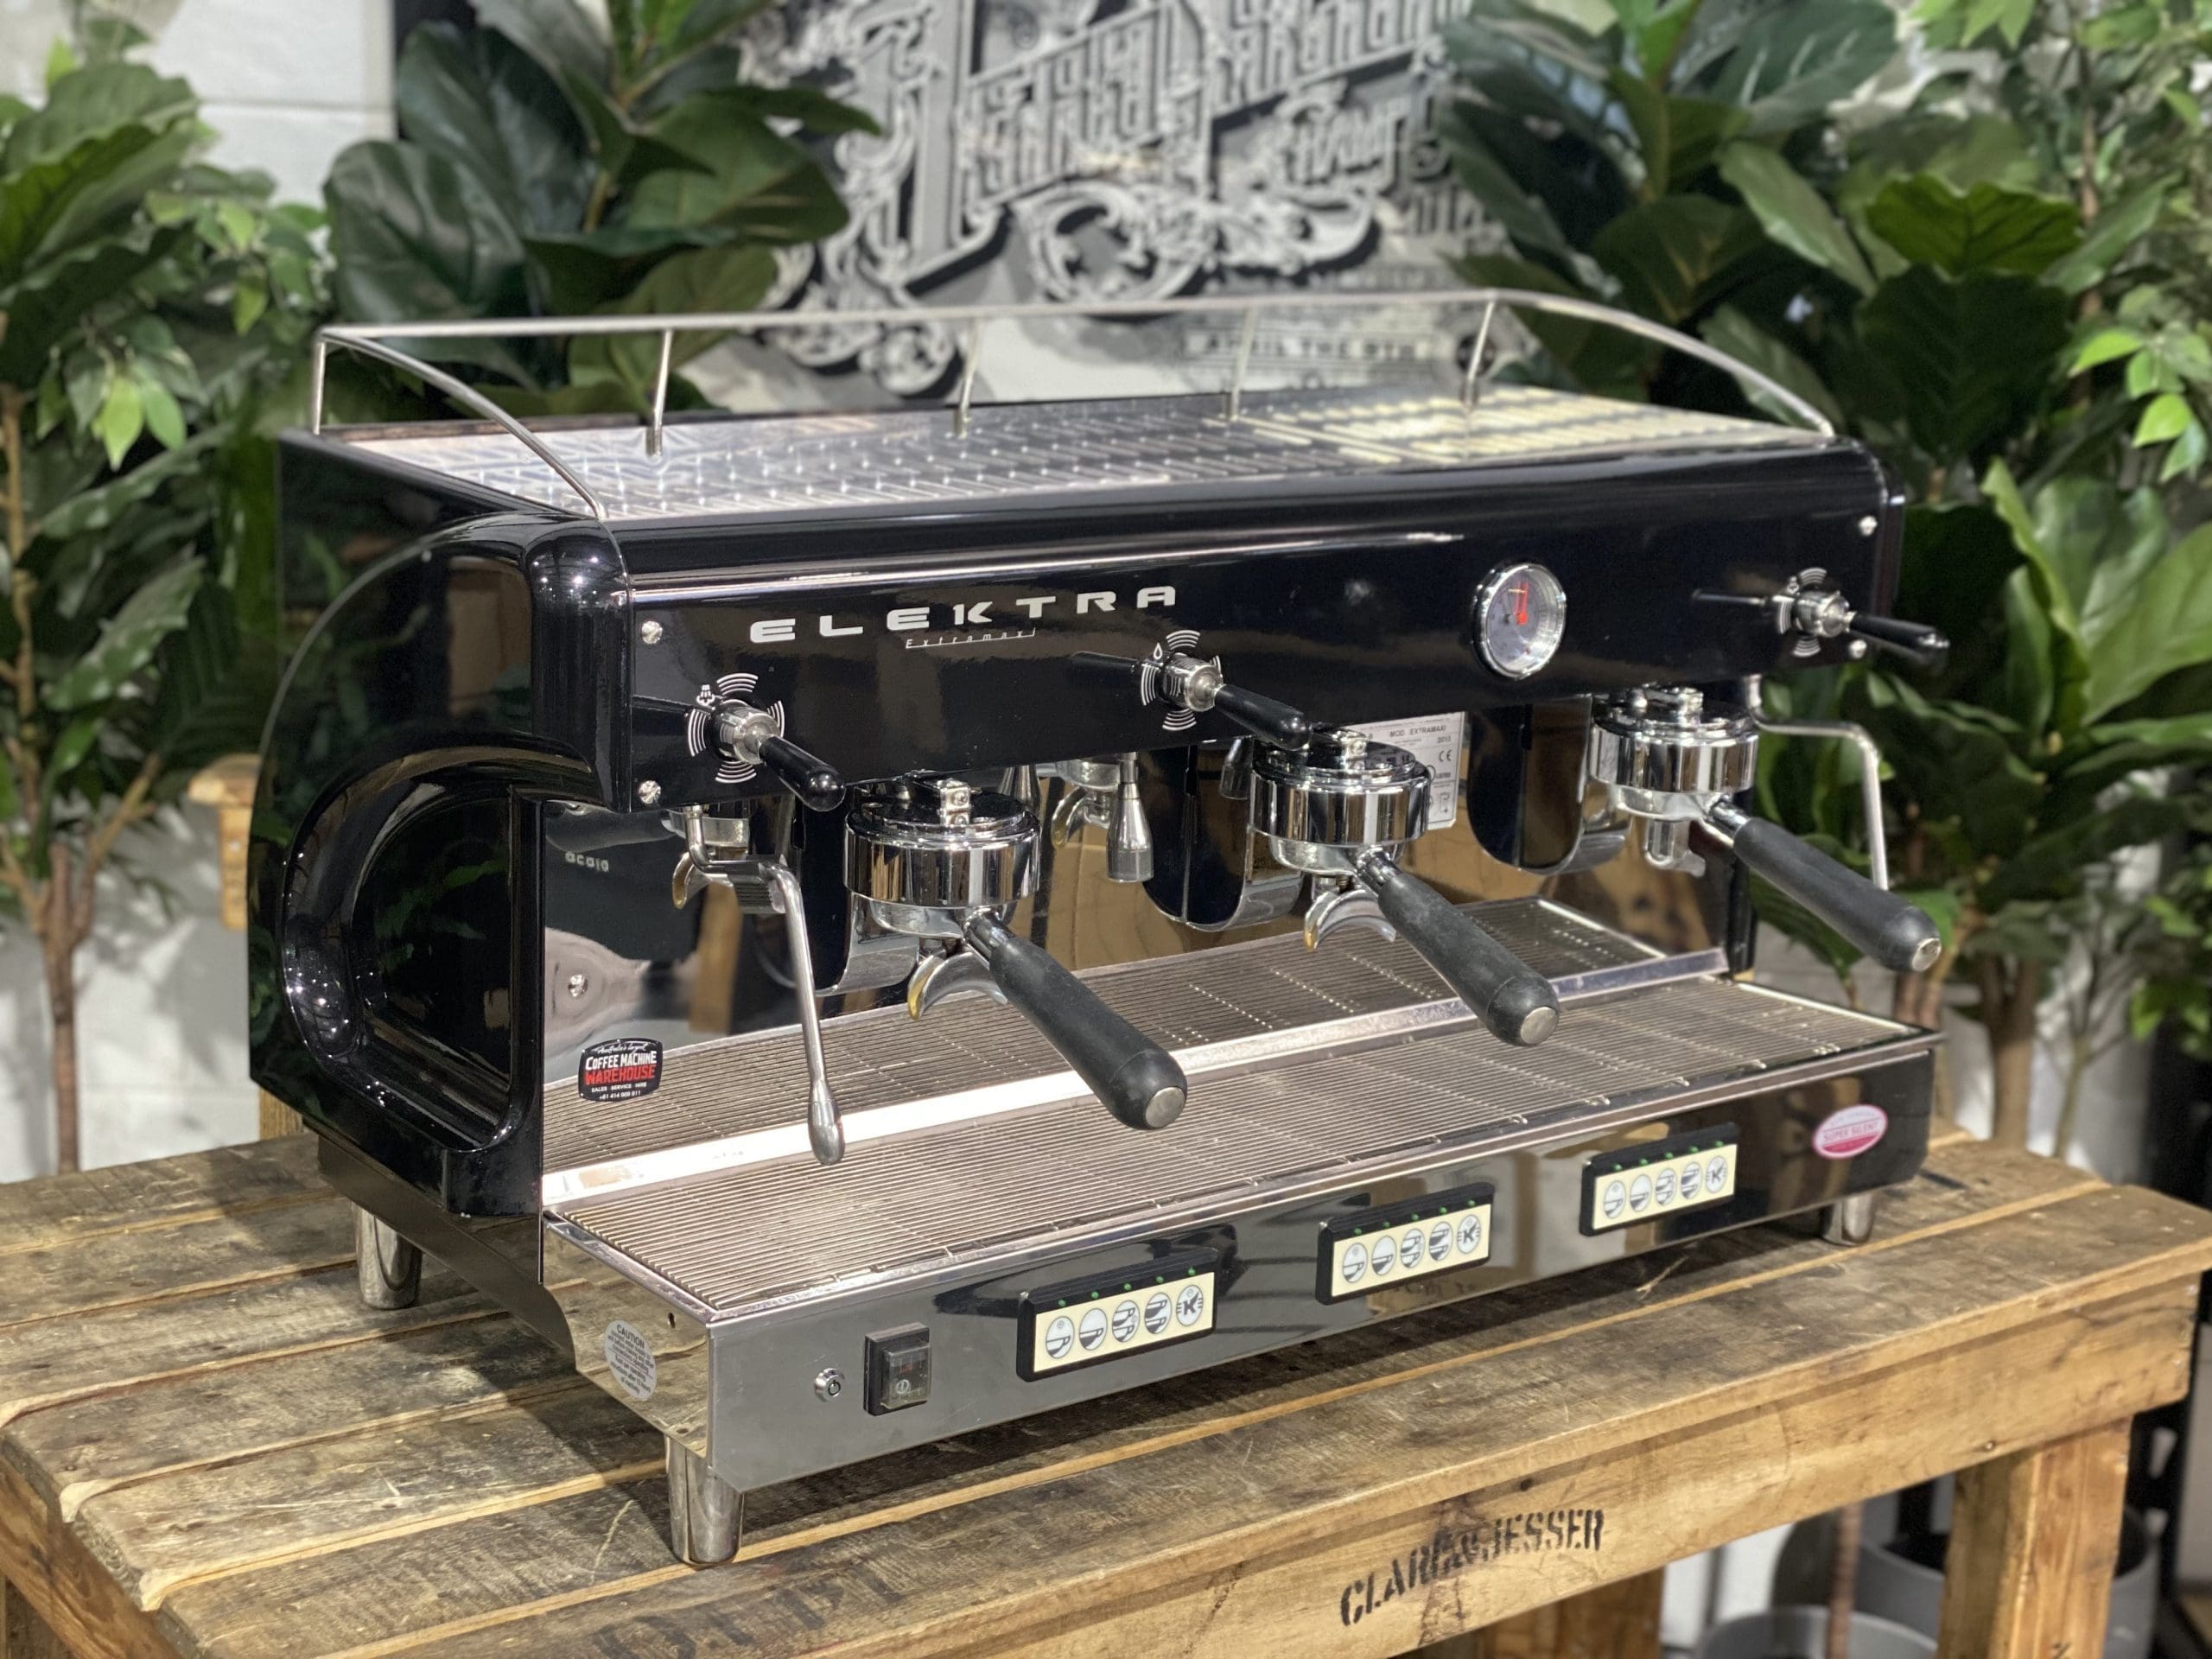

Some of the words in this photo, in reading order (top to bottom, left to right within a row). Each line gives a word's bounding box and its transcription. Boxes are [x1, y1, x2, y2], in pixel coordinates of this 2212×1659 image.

[750, 585, 1176, 644] ELEKTRA
[585, 1053, 620, 1071] COFFEE
[620, 1051, 657, 1068] MACHINE
[585, 1065, 656, 1085] WAREHOUSE
[616, 1324, 645, 1349] CAUTION
